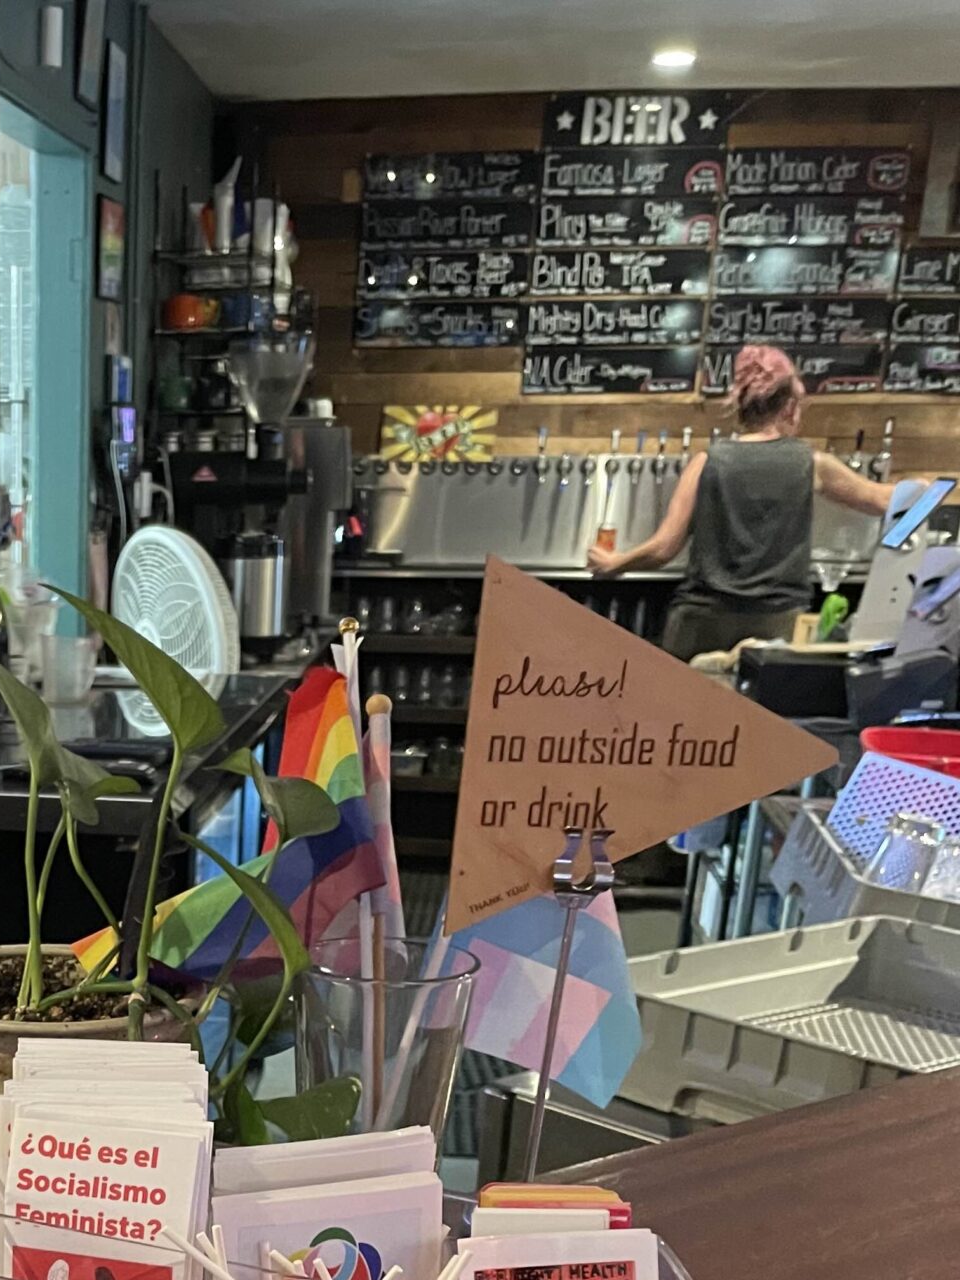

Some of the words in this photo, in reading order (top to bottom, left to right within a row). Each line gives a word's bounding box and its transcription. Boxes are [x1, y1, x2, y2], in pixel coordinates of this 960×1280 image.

[581, 96, 690, 146] BEER
[541, 203, 586, 240] Pliny
[492, 656, 628, 710] please!
[487, 734, 526, 763] no
[537, 721, 656, 766] outside
[667, 722, 740, 768] food
[480, 800, 517, 827] or
[526, 785, 609, 829] drink
[21, 1132, 92, 1161] ¿Qué
[97, 1144, 128, 1166] es
[134, 1146, 160, 1169] el
[16, 1168, 167, 1206] Socialismo
[15, 1202, 163, 1242] Feminista?
[568, 1263, 628, 1280] HEALTH
